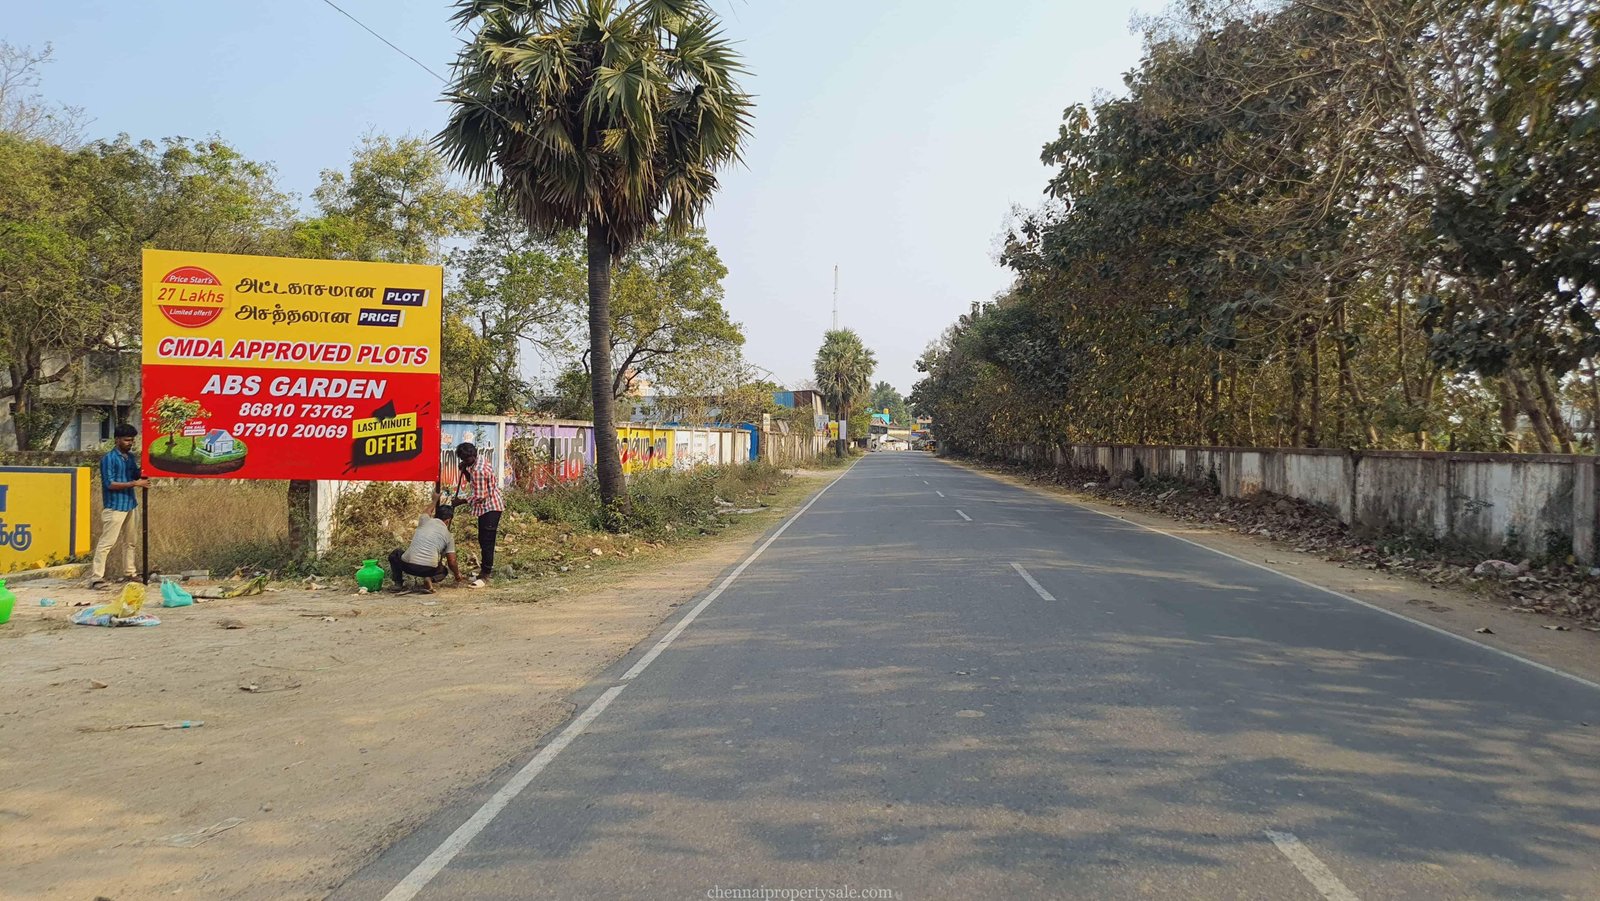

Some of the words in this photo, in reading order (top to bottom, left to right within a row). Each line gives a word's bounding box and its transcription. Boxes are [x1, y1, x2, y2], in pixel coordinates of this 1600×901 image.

[169, 275, 188, 284] Price
[190, 275, 213, 285] Start's
[157, 288, 176, 301] 27
[180, 288, 225, 303] Lakhs
[235, 277, 376, 299] அட்டகாசமான
[386, 291, 420, 303] PLOT
[169, 308, 192, 316] Limited
[234, 303, 352, 326] அசத்தலான
[359, 312, 398, 323] PRICE
[158, 337, 224, 359] CMDA
[229, 340, 351, 363] APPROVED
[356, 345, 429, 365] PLOTS
[201, 374, 261, 396] ABS
[269, 376, 387, 399] GARDEN
[238, 402, 295, 418] 86810
[300, 403, 354, 419] 73762
[232, 422, 288, 438] 97910
[292, 423, 348, 439] 20069
[357, 419, 379, 433] LAST
[380, 416, 412, 430] MINUTE
[365, 433, 418, 456] OFFER
